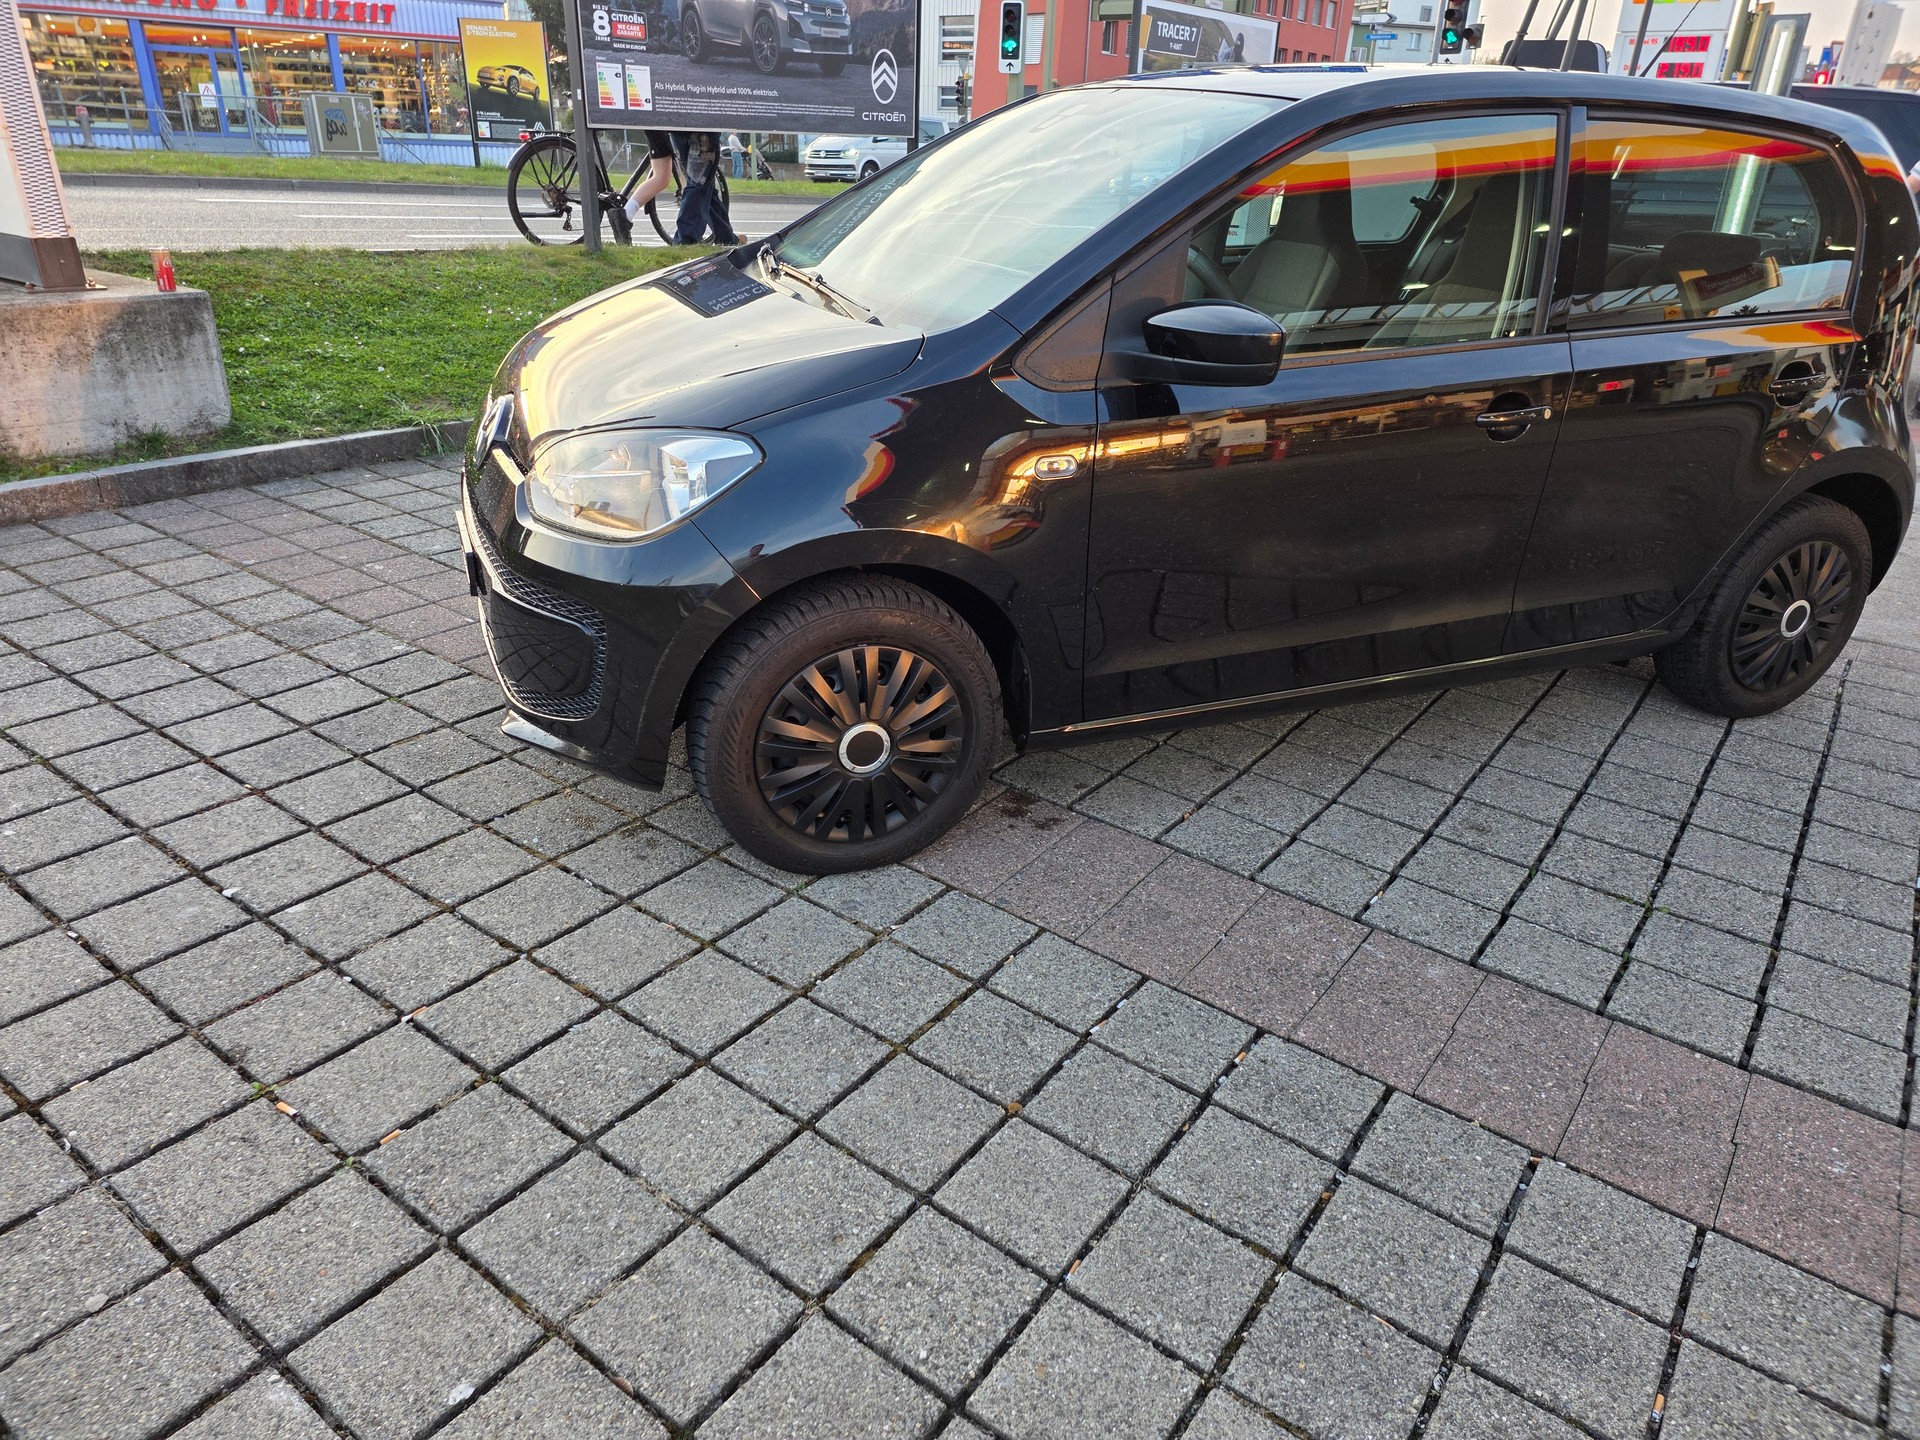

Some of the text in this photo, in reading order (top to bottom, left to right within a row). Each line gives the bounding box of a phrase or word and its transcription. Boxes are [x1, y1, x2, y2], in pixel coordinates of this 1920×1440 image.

[266, 0, 395, 24] FREIZEIT
[593, 10, 611, 36] 8
[1157, 21, 1197, 42] TRACER 7
[654, 82, 665, 90] Als
[665, 83, 686, 93] Hybrid,
[687, 84, 706, 94] Plug-in
[707, 86, 725, 94] Hybrid
[738, 87, 752, 95] 100%
[753, 89, 779, 97] elektrisch.
